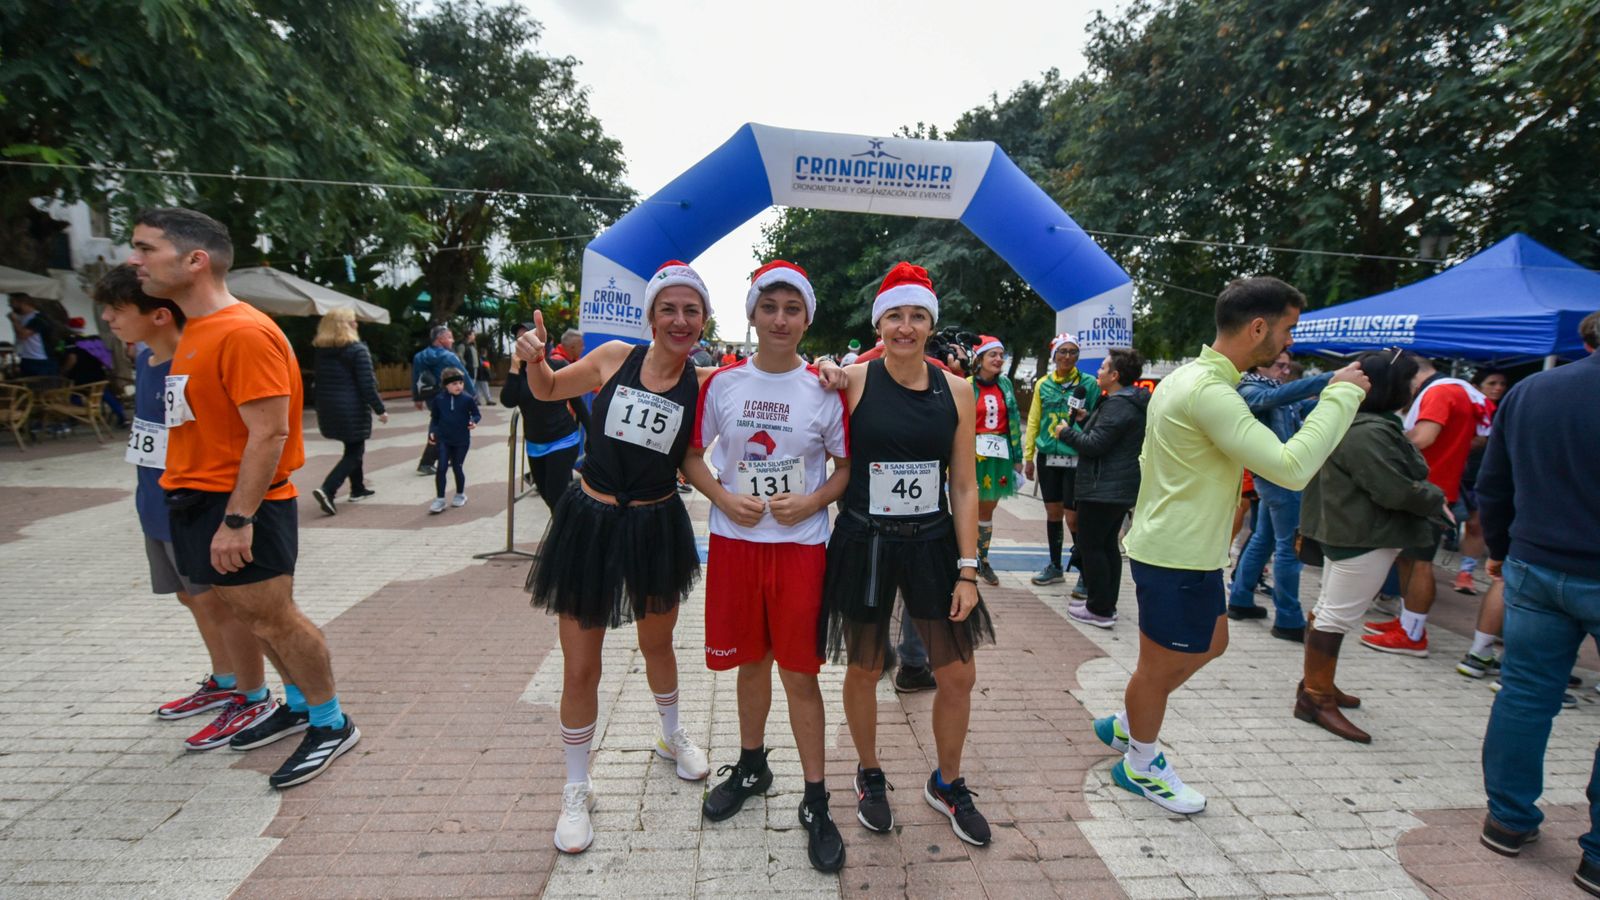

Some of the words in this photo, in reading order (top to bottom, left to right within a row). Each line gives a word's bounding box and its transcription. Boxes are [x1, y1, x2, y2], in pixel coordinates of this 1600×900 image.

[795, 155, 953, 190] CRONOFINISHER
[792, 182, 848, 194] CRONOMETRAJE
[919, 192, 952, 200] EVENTOS
[593, 289, 631, 306] CRONO
[582, 302, 642, 326] FINISHER
[1093, 317, 1127, 330] CRONO
[1290, 315, 1419, 337] RONOFINISHER
[636, 391, 650, 400] SAN
[651, 395, 680, 413] SILVESTRE
[744, 400, 750, 410] II
[751, 400, 790, 414] CARRERA
[621, 404, 668, 434] 115
[742, 410, 756, 418] SAN
[756, 411, 789, 422] SILVESTRE
[782, 425, 793, 433] 2023
[986, 440, 1000, 451] 76
[767, 458, 801, 468] SILVESTRE
[905, 462, 937, 470] SILVESTRE
[750, 473, 791, 497] 131
[891, 478, 922, 499] 46
